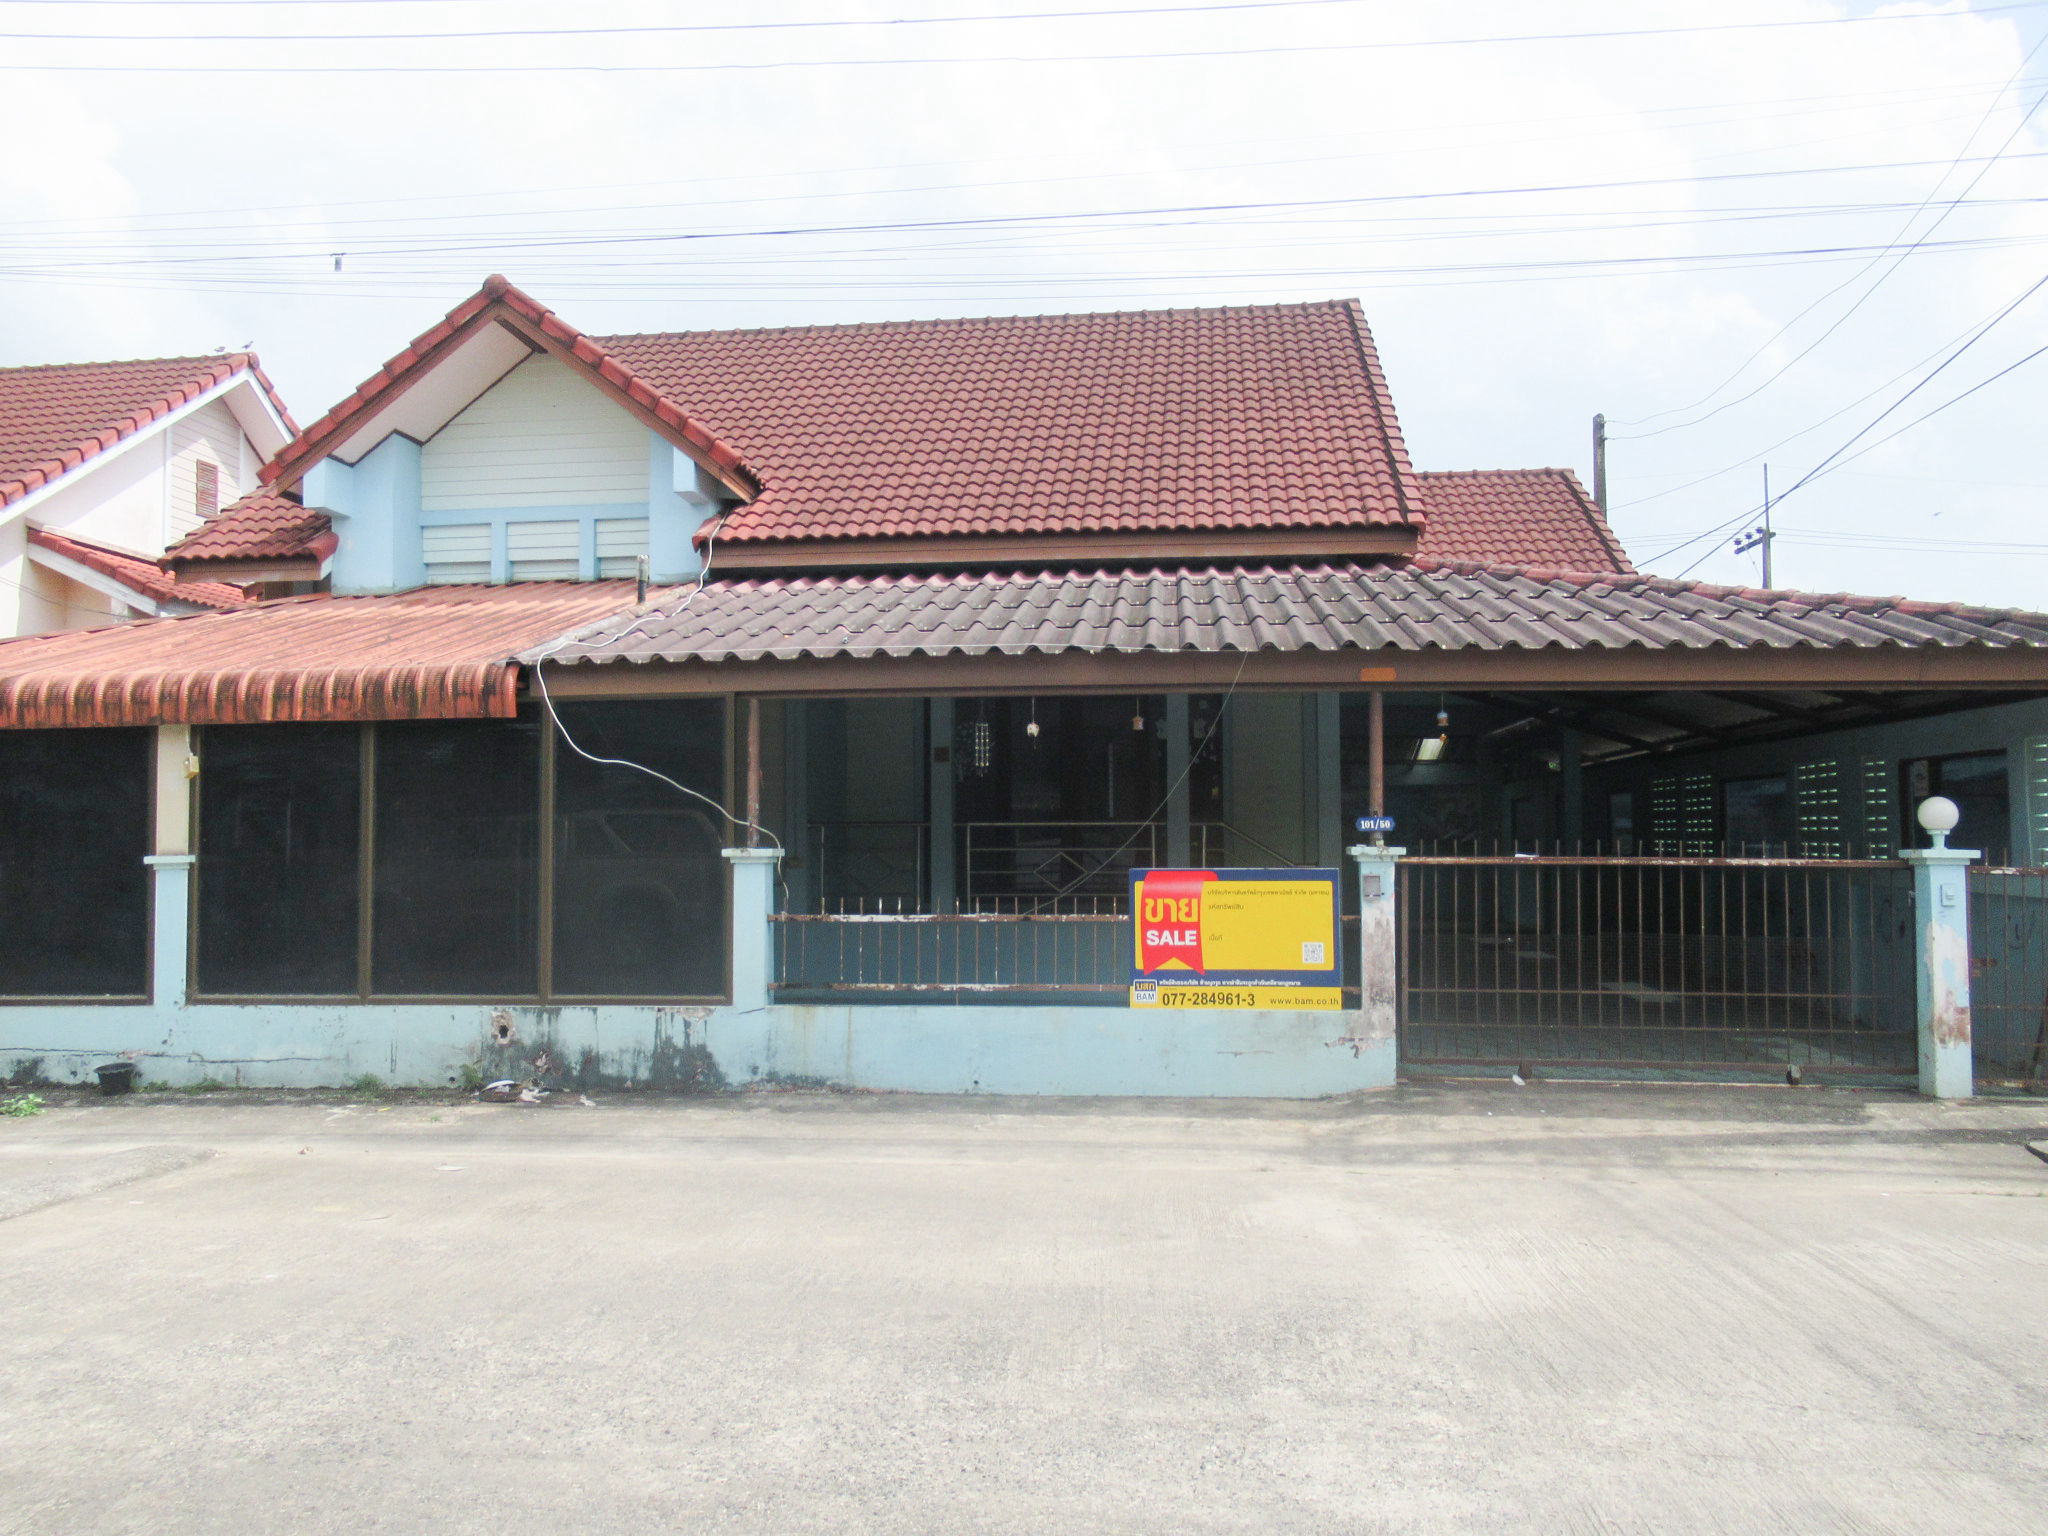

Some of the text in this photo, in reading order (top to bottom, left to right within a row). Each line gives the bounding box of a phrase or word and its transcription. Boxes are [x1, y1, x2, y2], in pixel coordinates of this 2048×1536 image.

[1361, 818, 1390, 830] 101/50
[1145, 898, 1199, 923] ขาย
[1146, 930, 1197, 946] SALE
[1136, 992, 1155, 1001] BAM
[1162, 992, 1256, 1006] 077-284961-3
[1270, 997, 1339, 1005] www.bam.co.th
